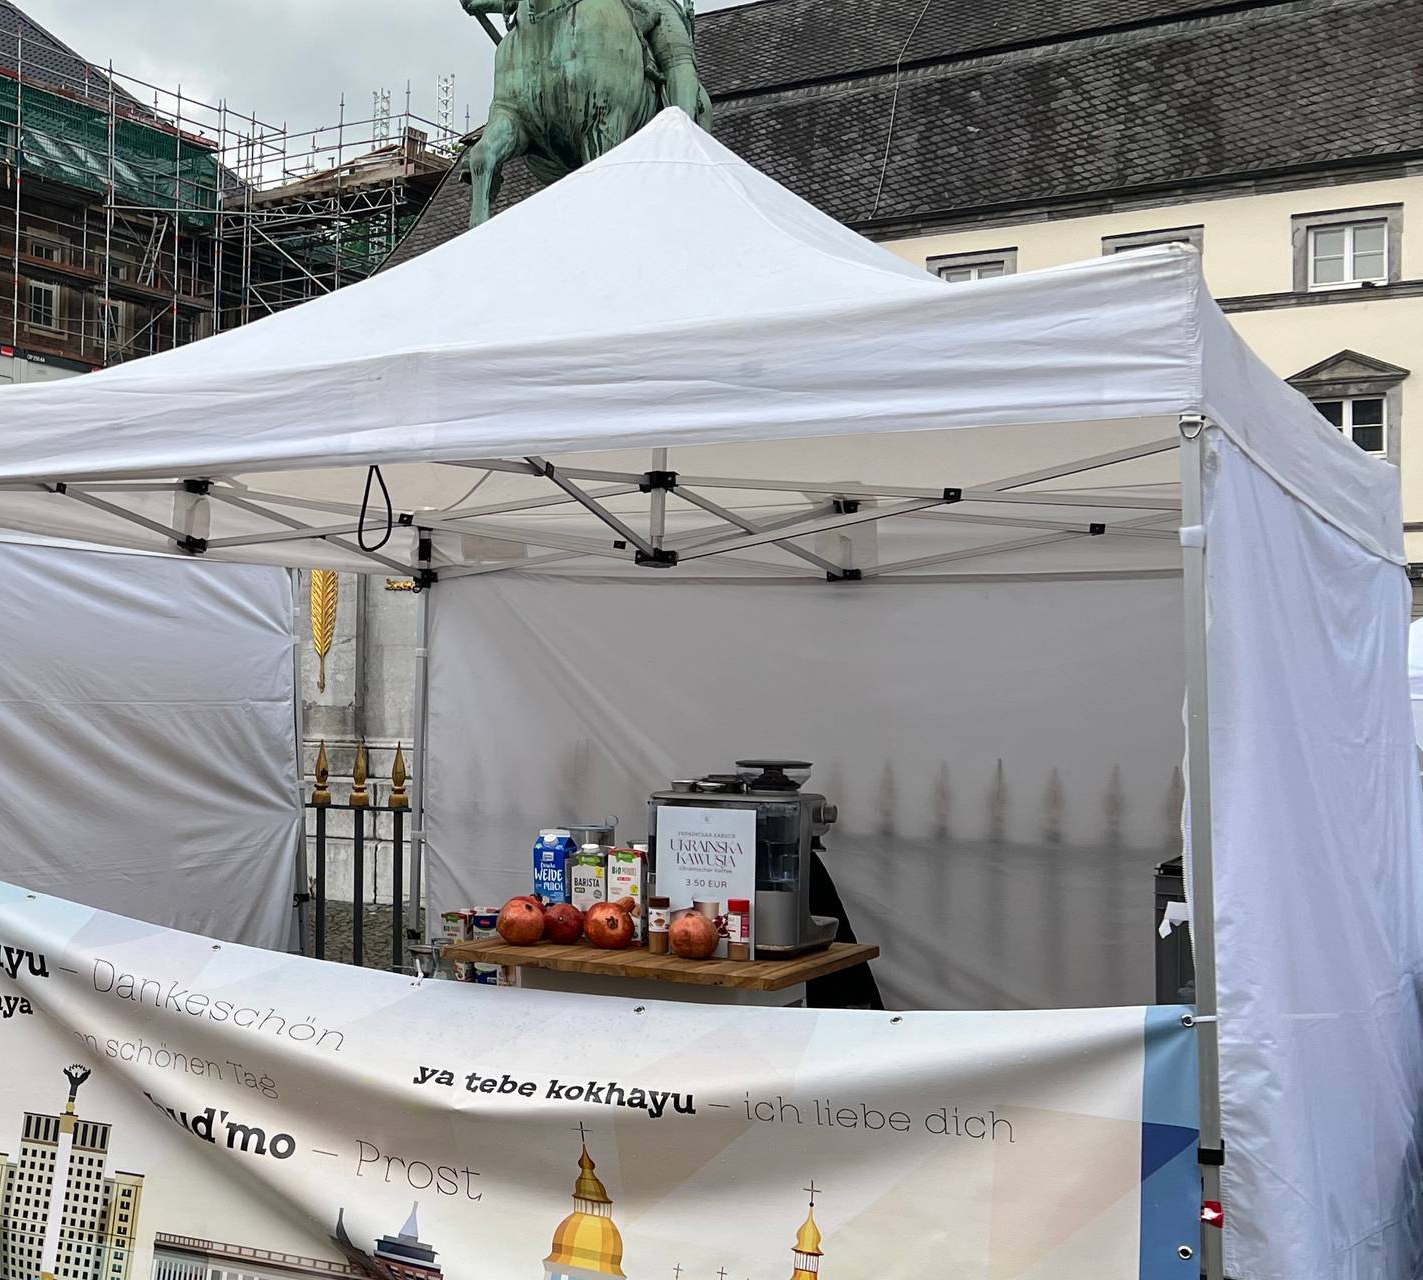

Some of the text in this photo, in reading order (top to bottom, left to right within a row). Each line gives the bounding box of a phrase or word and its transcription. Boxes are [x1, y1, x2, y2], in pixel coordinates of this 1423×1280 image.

[534, 868, 563, 882] WEIDE
[573, 877, 600, 888] BARISTA
[708, 880, 728, 889] EUR
[90, 957, 346, 1052] Dankeschön
[104, 1037, 223, 1082] schönen
[227, 1060, 280, 1100] Tag
[412, 1065, 455, 1087] ya
[464, 1070, 537, 1098] tebe
[544, 1079, 697, 1119] kokhayu
[744, 1091, 803, 1128] ich
[815, 1098, 913, 1136] liebe
[924, 1104, 1017, 1144] dich
[355, 1139, 483, 1202] Prost
